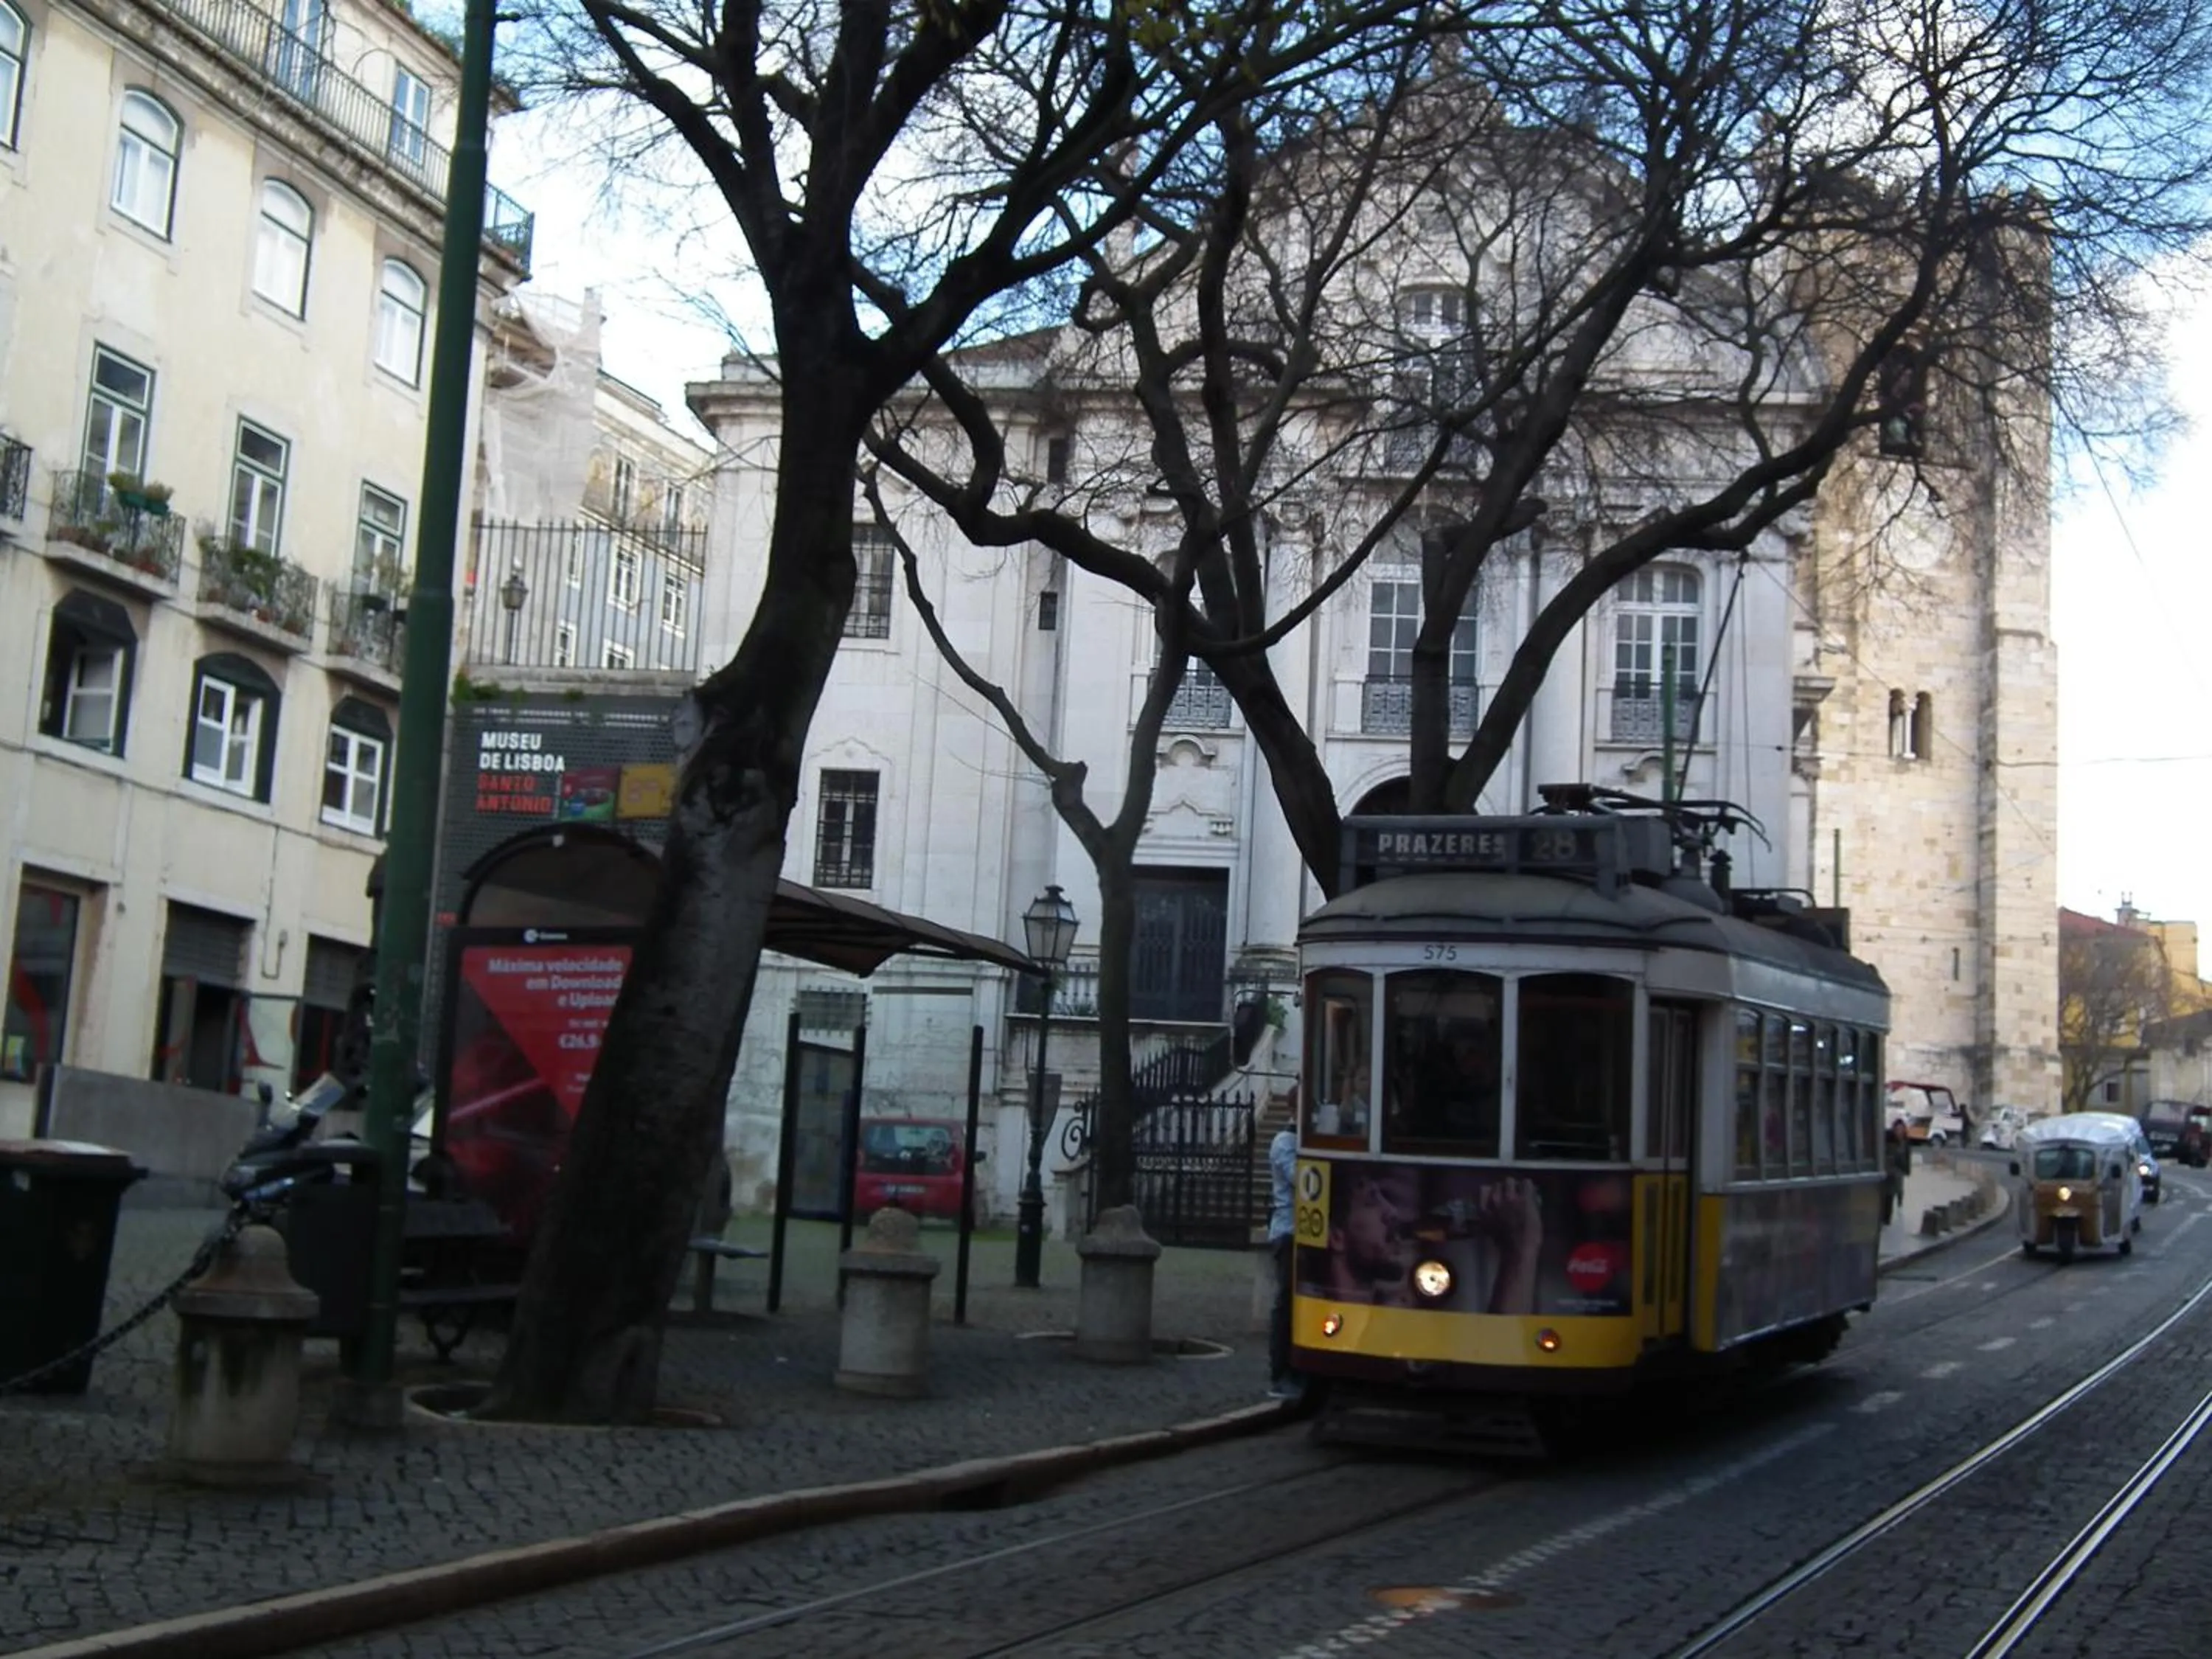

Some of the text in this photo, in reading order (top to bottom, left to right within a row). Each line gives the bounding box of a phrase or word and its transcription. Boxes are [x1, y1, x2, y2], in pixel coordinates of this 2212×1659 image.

[481, 731, 542, 750] MUSEU
[479, 753, 565, 772] DE LISBOA
[478, 773, 537, 792] SANTO
[1378, 830, 1576, 861] PRAZERES 28
[1424, 945, 1458, 961] 575
[488, 957, 623, 973] Máxima velocidade
[526, 974, 623, 990] em Download
[557, 994, 567, 1006] e
